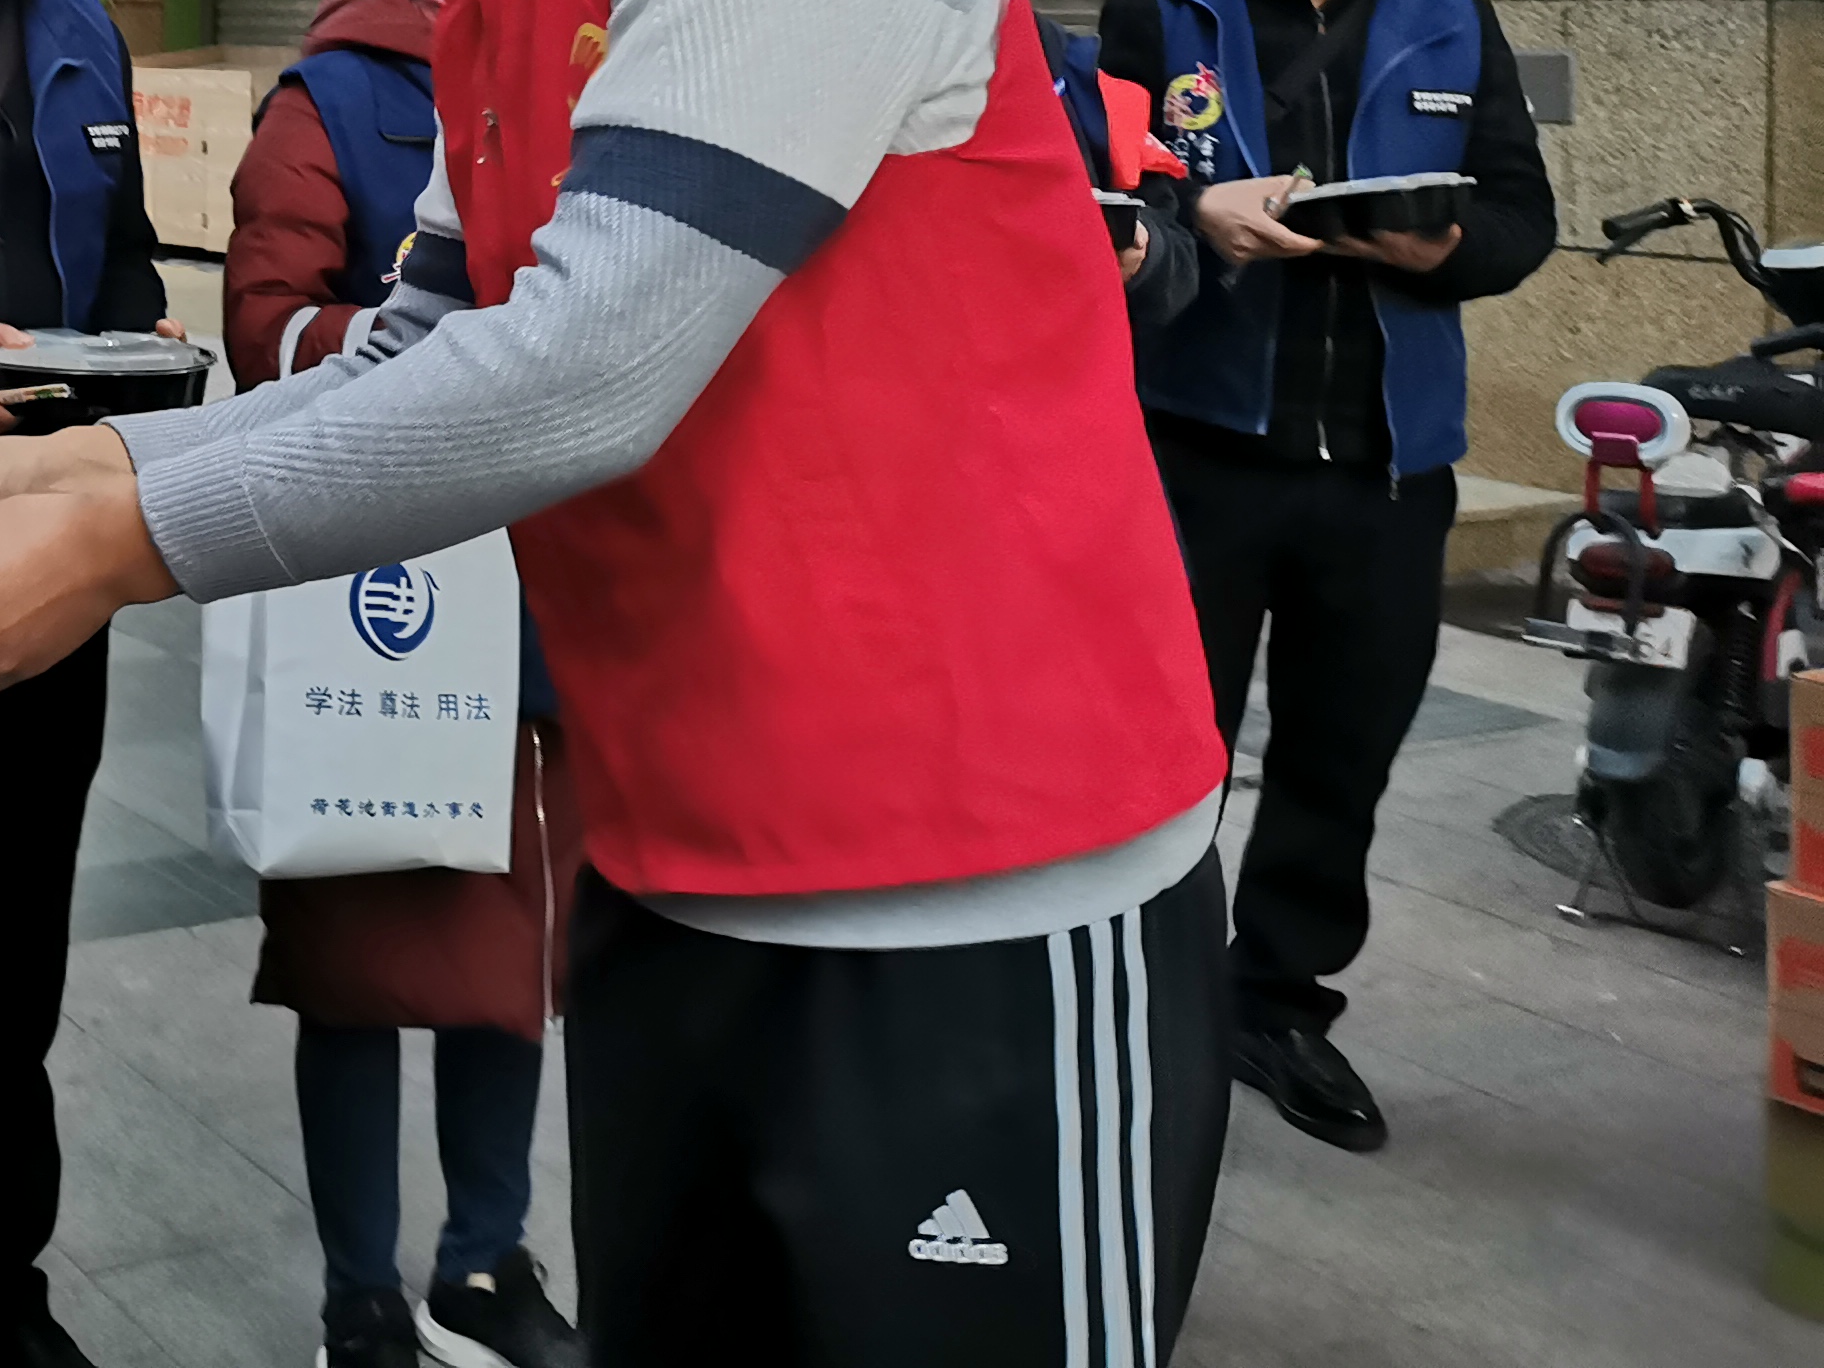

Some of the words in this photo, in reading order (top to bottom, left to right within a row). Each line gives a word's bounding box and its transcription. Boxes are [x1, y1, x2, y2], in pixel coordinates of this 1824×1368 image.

[305, 686, 363, 717] 学法
[378, 690, 421, 720] 尊法
[436, 693, 491, 721] 用法
[310, 798, 484, 819] 荷花池街道办事处
